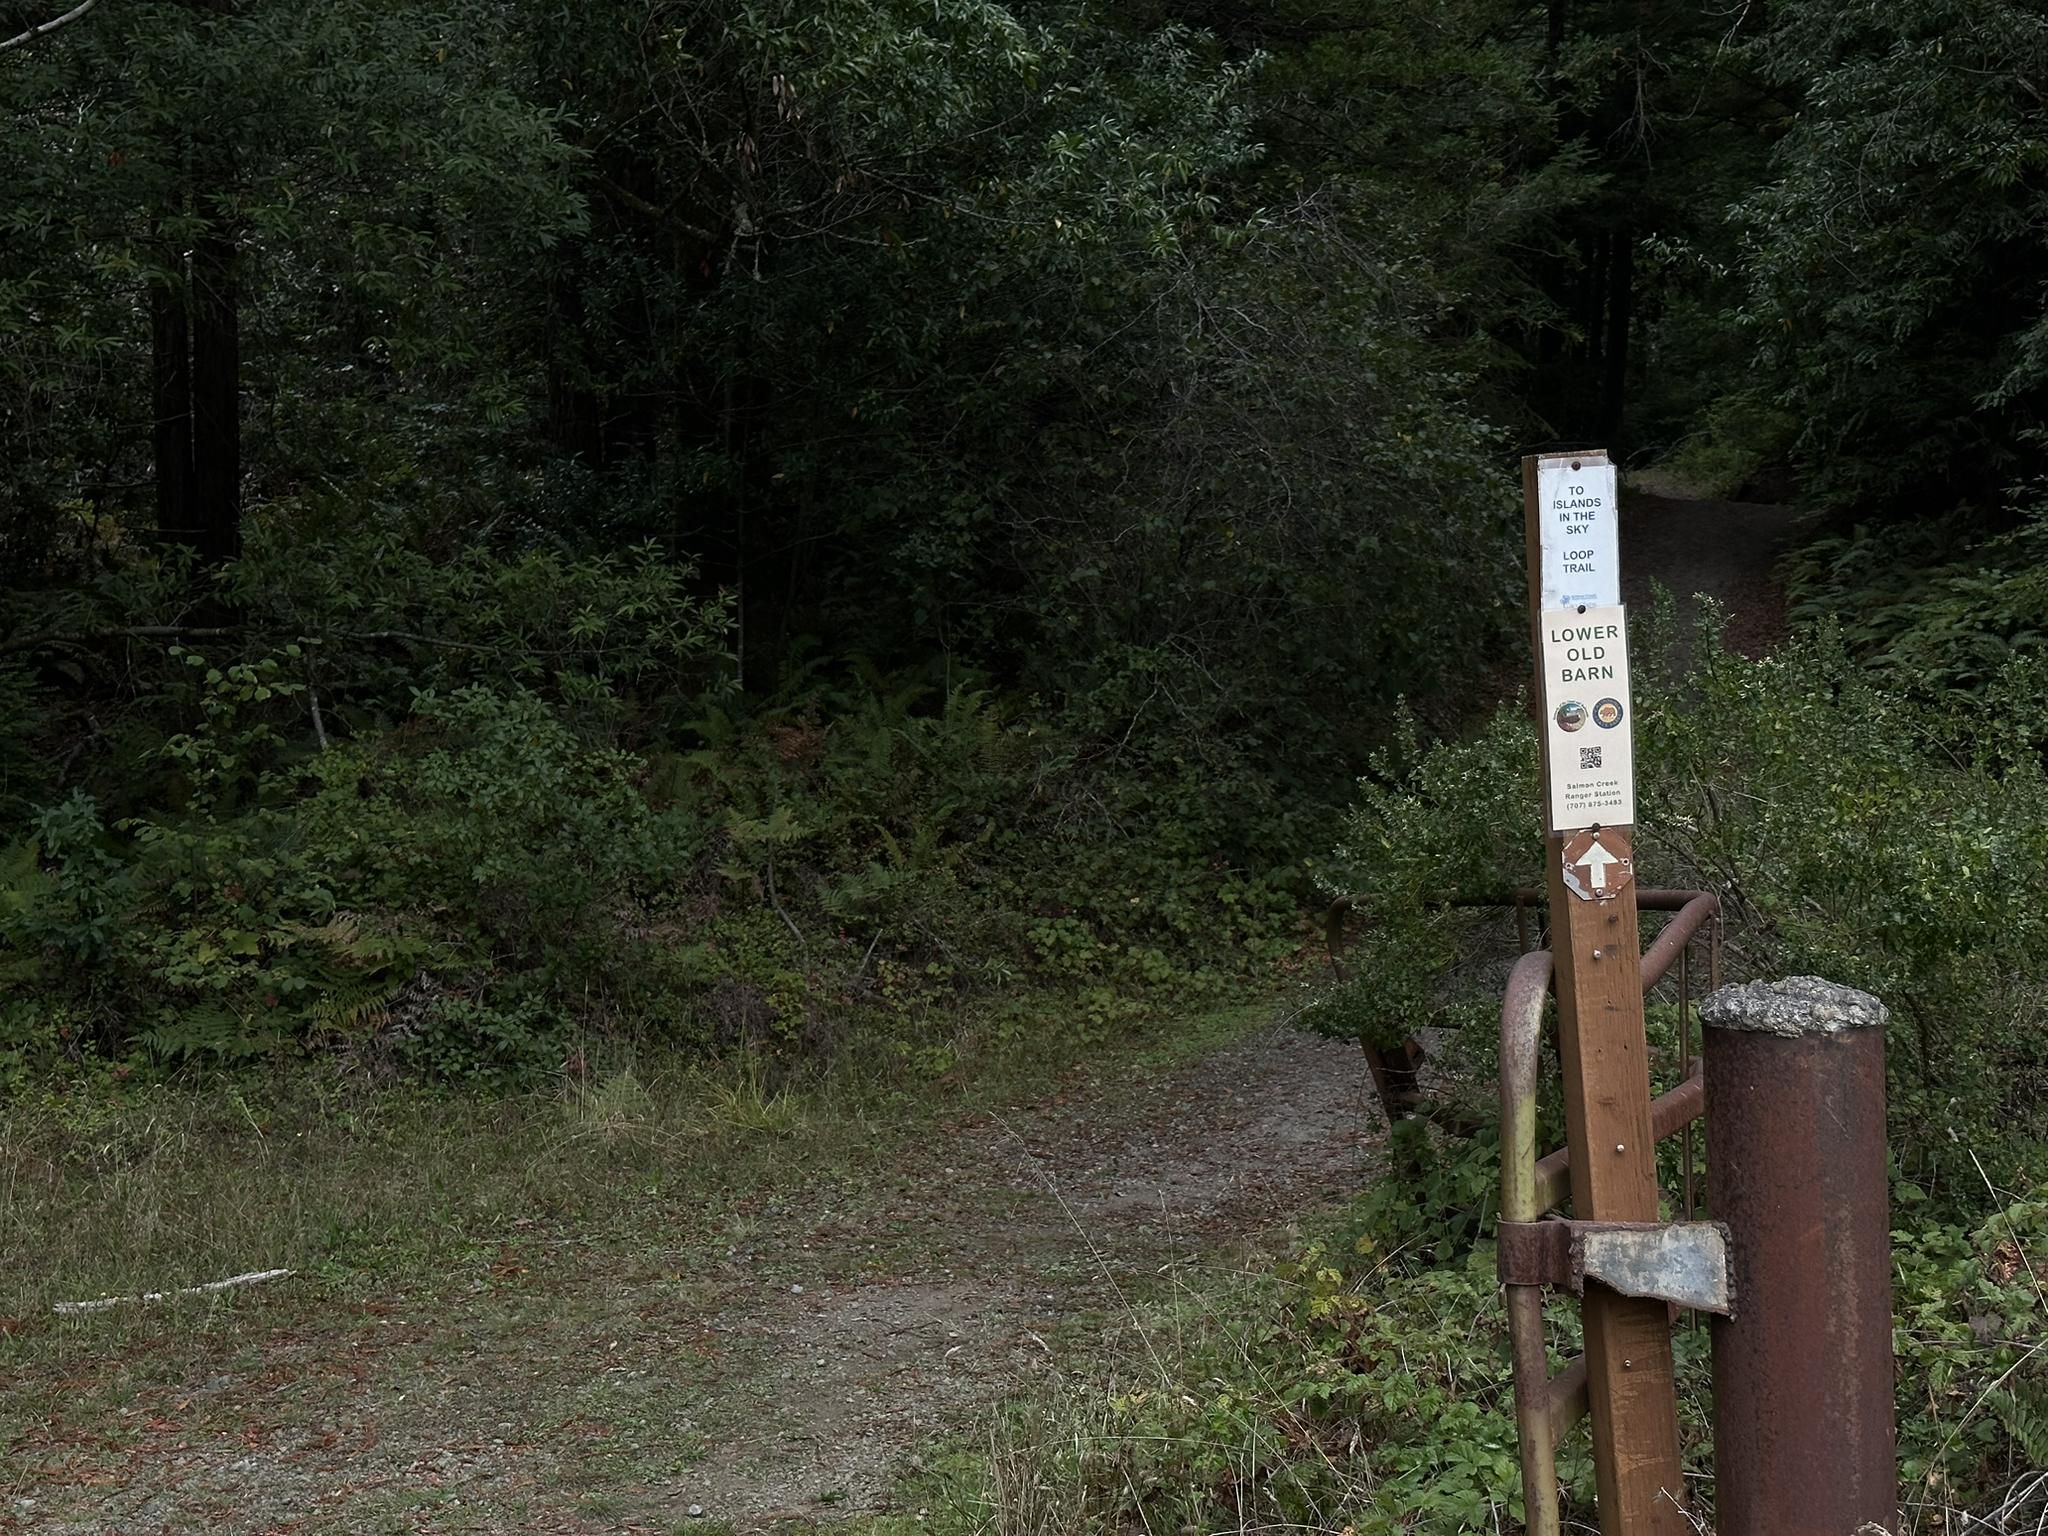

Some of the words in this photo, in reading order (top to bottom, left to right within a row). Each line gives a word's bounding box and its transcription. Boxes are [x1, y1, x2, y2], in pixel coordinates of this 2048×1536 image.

[1568, 486, 1584, 495] TO
[1553, 498, 1601, 509] ISLANDS
[1560, 513, 1570, 522] IN
[1574, 511, 1595, 521] THE
[1566, 524, 1589, 535] SKY
[1563, 550, 1594, 560] LOOP
[1563, 563, 1595, 573] TRAIL
[1552, 625, 1618, 642] LOWER
[1567, 647, 1605, 661] OLD
[1562, 666, 1613, 682] BARN
